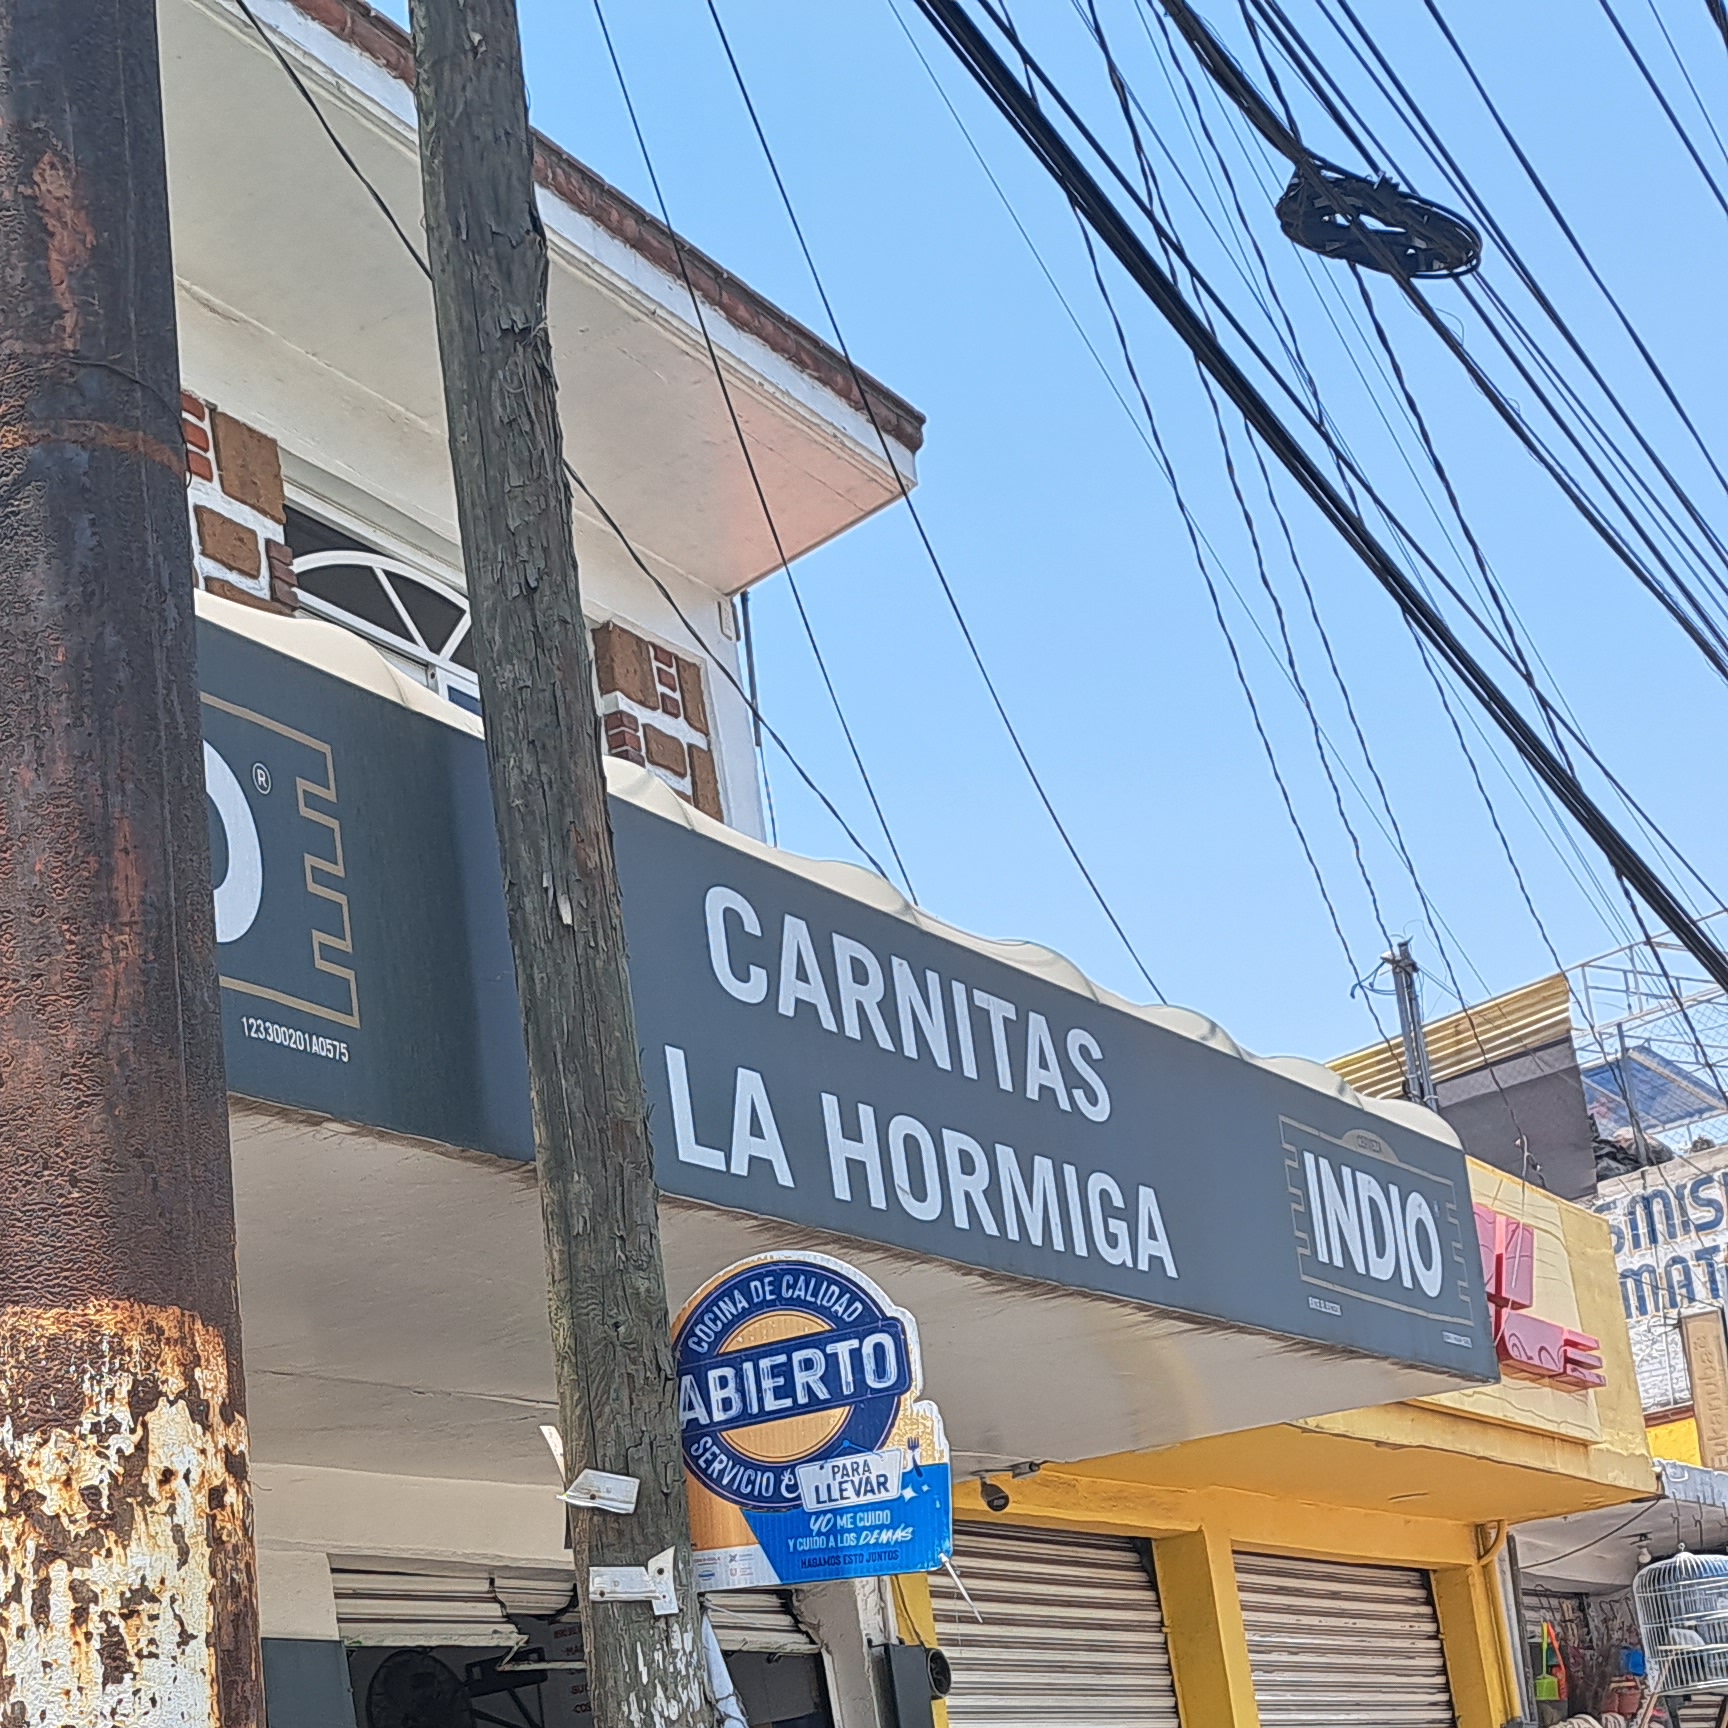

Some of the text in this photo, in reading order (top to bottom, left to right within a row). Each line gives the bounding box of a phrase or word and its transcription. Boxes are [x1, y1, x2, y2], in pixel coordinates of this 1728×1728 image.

[704, 884, 1112, 1123] CARNITAS
[241, 1016, 350, 1063] 123300201A0575
[664, 1044, 1179, 1280] LA HORMIGA
[1303, 1150, 1443, 1298] INDIO
[687, 1274, 863, 1354] COCINA DE CALIDAD
[678, 1333, 898, 1430] ABIERTO
[690, 1436, 774, 1498] SERVICIO
[814, 1473, 891, 1504] LLEVAR
[831, 1459, 873, 1482] PARA
[787, 1523, 914, 1552] Y CUIDO A LOS DEMÁS
[809, 1510, 891, 1536] YO ME CUIDO
[843, 1553, 864, 1565] ESTO
[865, 1549, 900, 1564] JUNTOS
